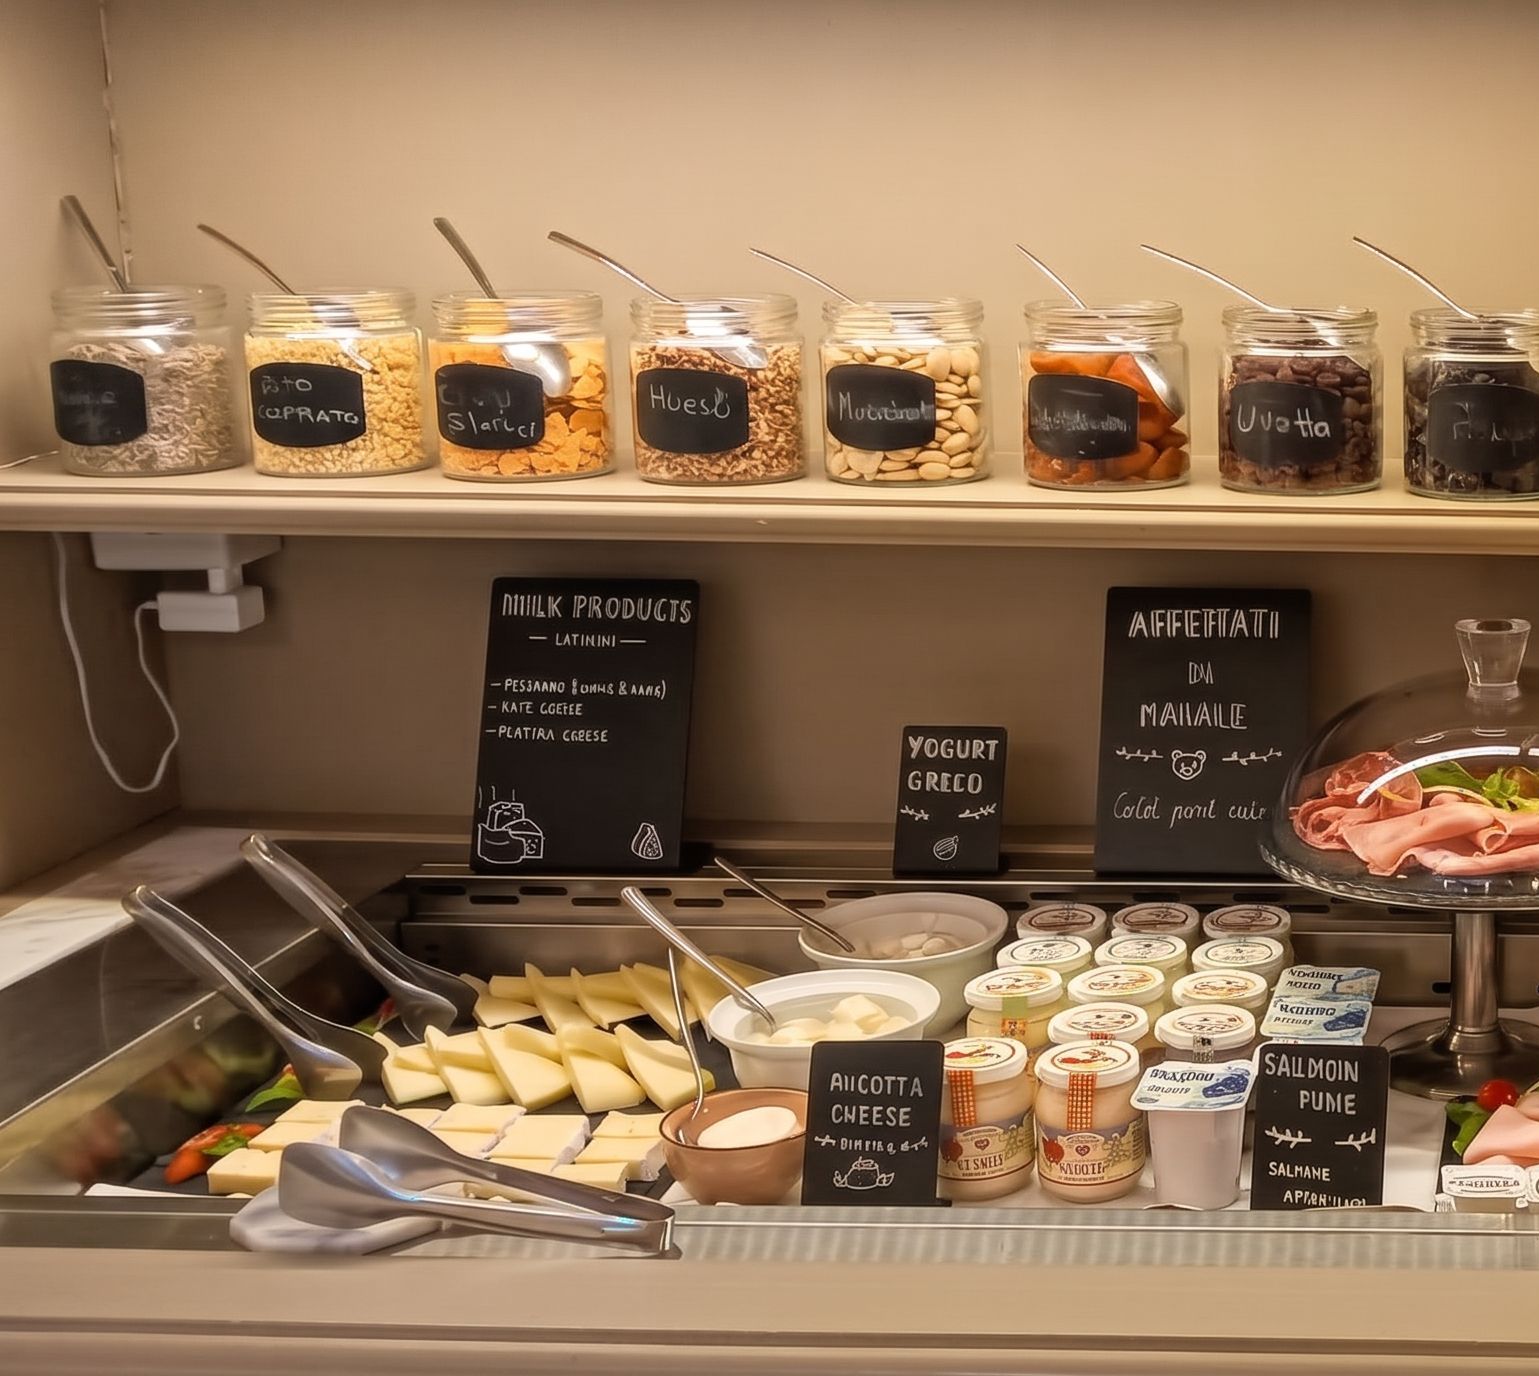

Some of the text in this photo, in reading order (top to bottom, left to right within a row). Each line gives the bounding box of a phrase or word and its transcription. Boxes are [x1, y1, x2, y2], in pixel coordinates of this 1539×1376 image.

[908, 735, 999, 761] YOGURT
[907, 770, 983, 794] GRECO
[831, 1104, 912, 1127] CHEESE
